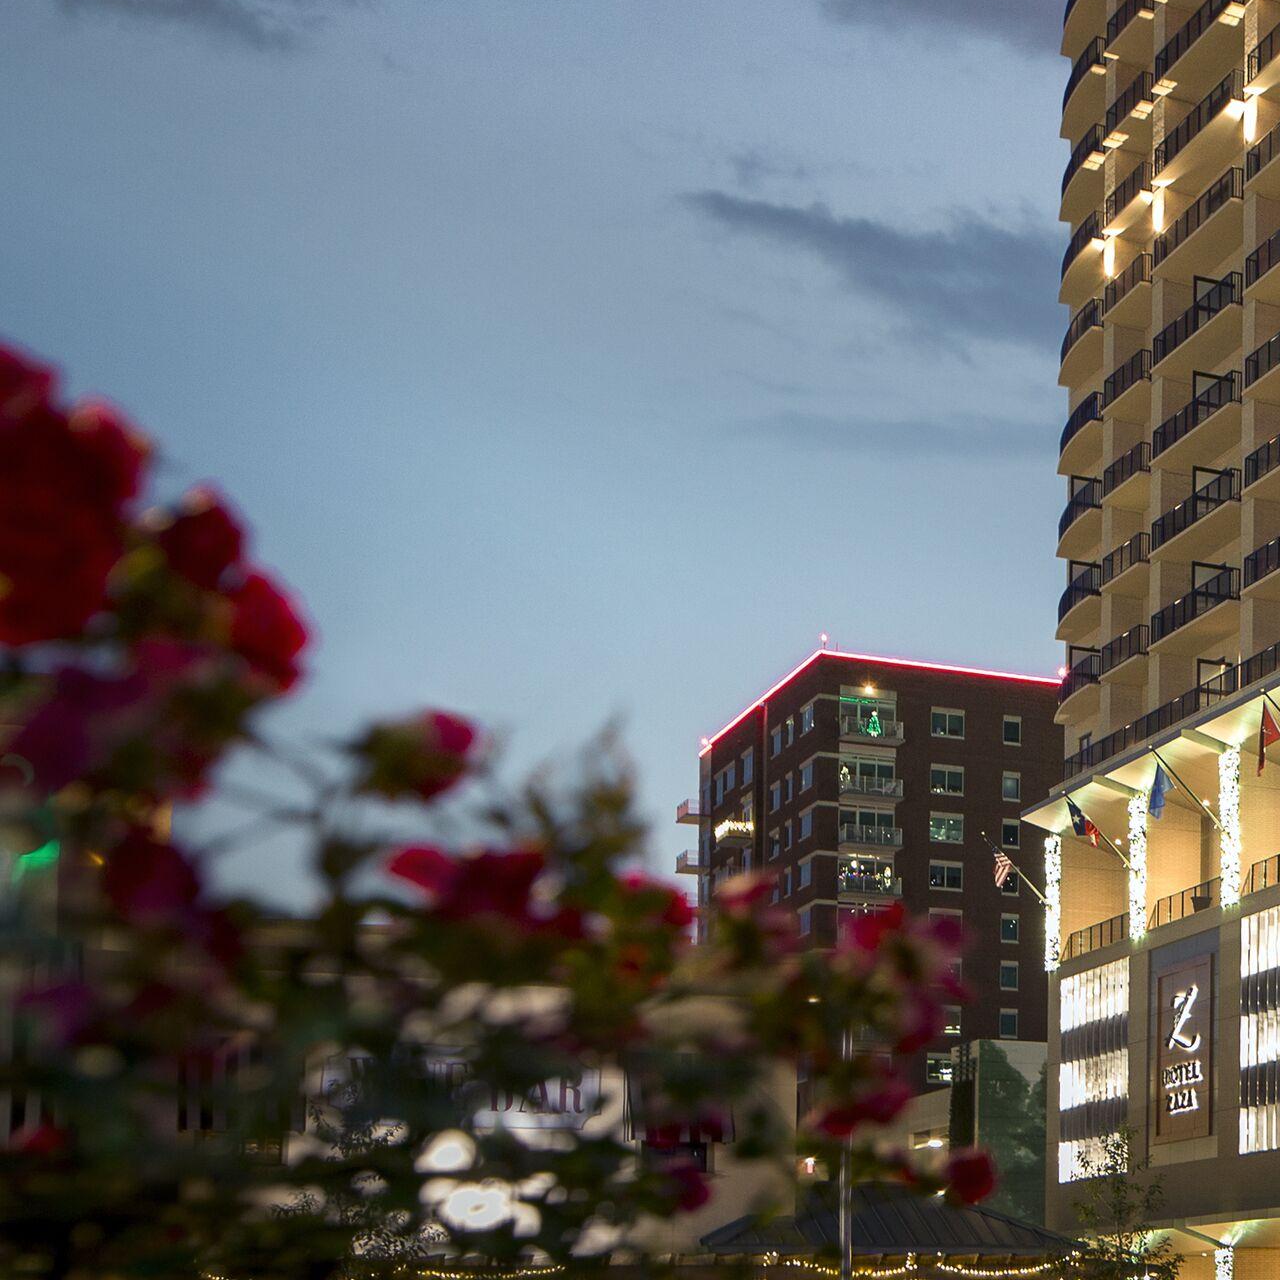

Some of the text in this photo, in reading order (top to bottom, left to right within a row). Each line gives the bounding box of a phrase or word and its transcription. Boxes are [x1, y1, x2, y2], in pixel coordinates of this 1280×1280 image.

[1165, 984, 1201, 1052] Z
[1162, 1059, 1203, 1089] HOTEL
[1166, 1088, 1200, 1114] ZAZA
